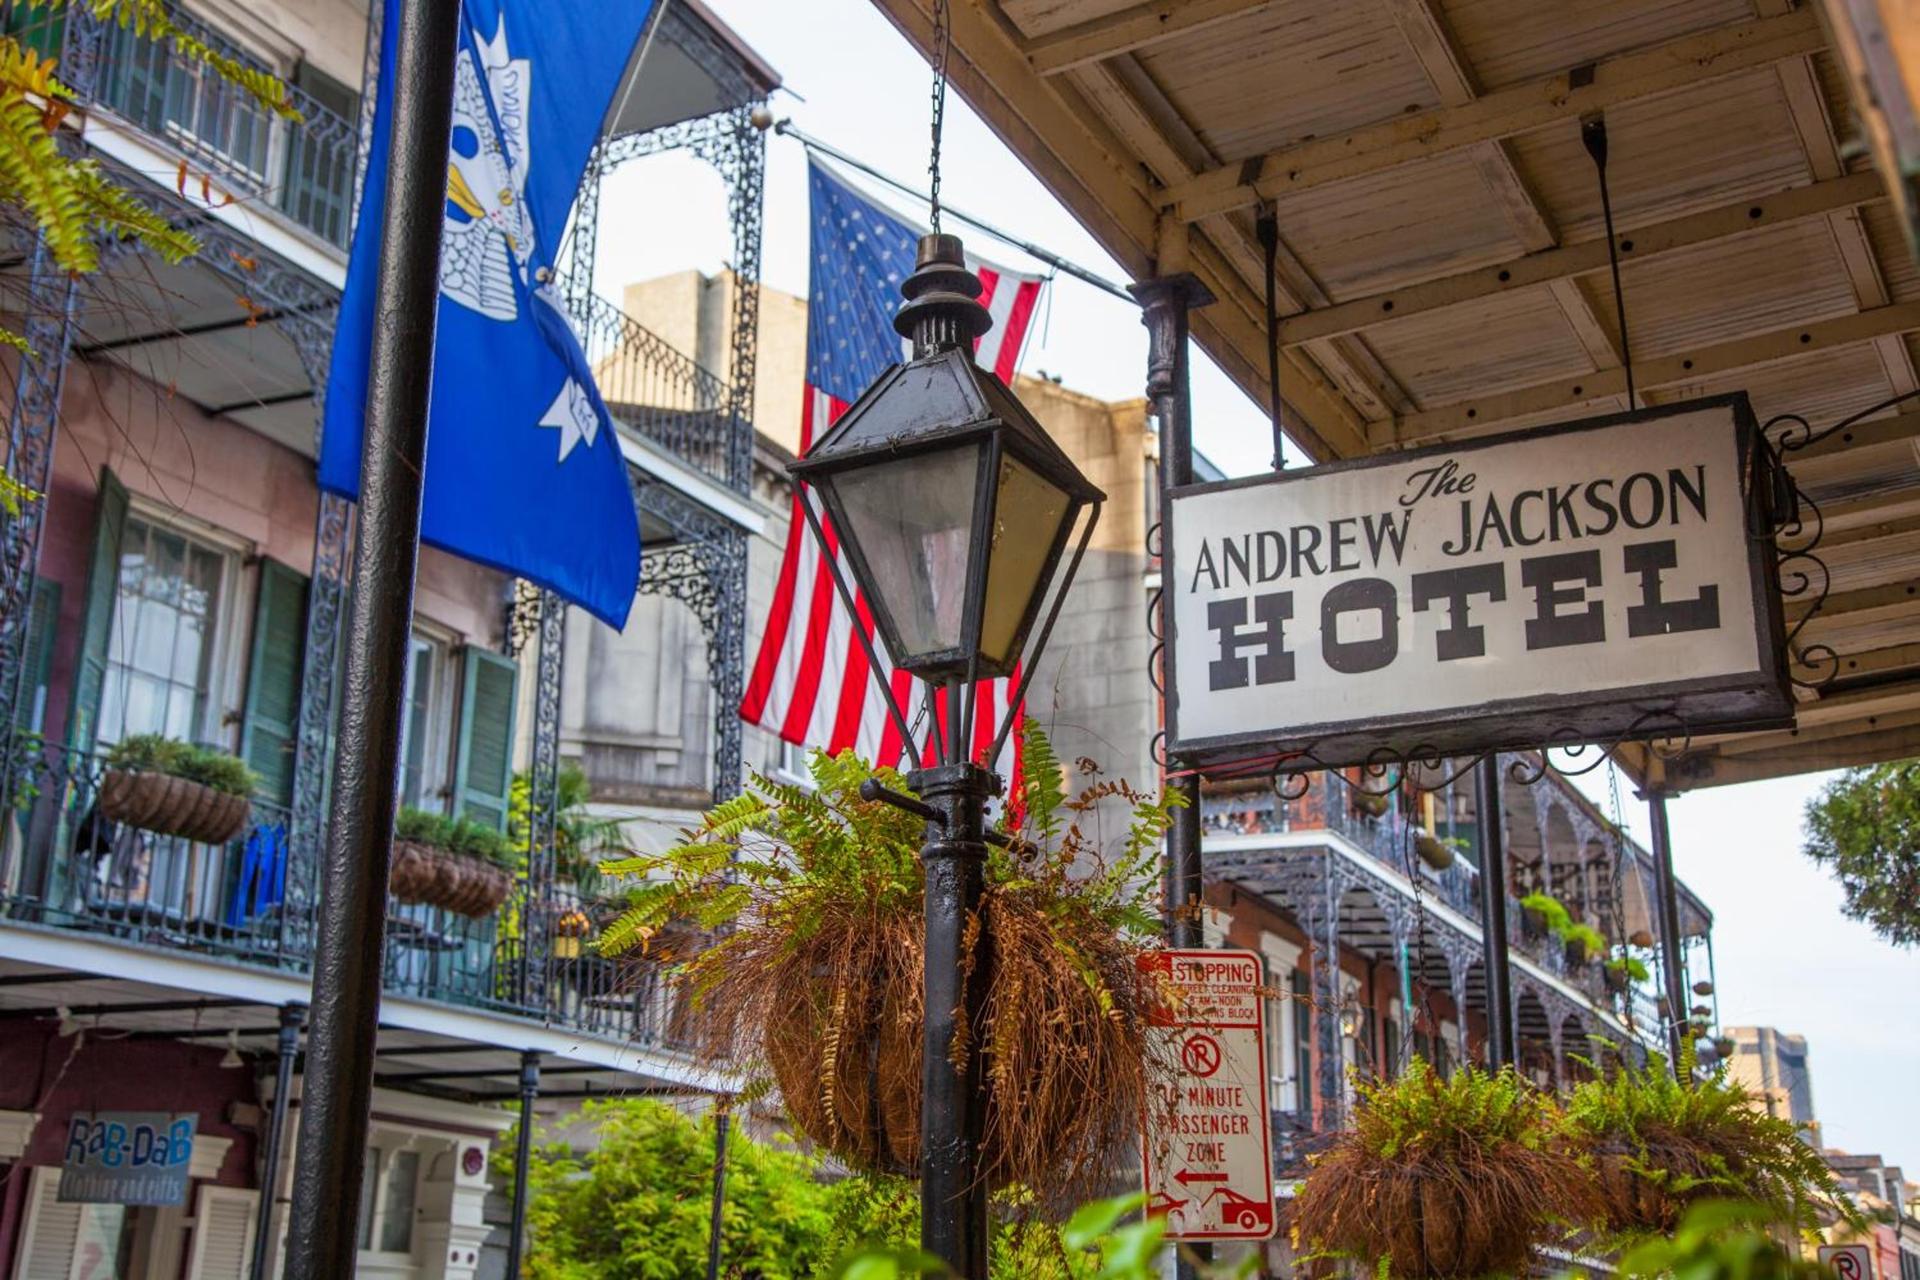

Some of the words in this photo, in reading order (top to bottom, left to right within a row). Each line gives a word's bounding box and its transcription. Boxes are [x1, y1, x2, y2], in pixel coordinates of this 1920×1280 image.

[1398, 459, 1477, 506] The
[1190, 509, 1415, 593] ANDREW
[1442, 465, 1707, 556] JACKSON
[1207, 539, 1721, 692] HOTEL
[1176, 963, 1253, 982] STOPPING
[1228, 1007, 1255, 1018] BLOCK
[1188, 1087, 1243, 1107] MINUTE
[1156, 1114, 1249, 1134] PASSENGER
[1186, 1142, 1226, 1162] ZONE
